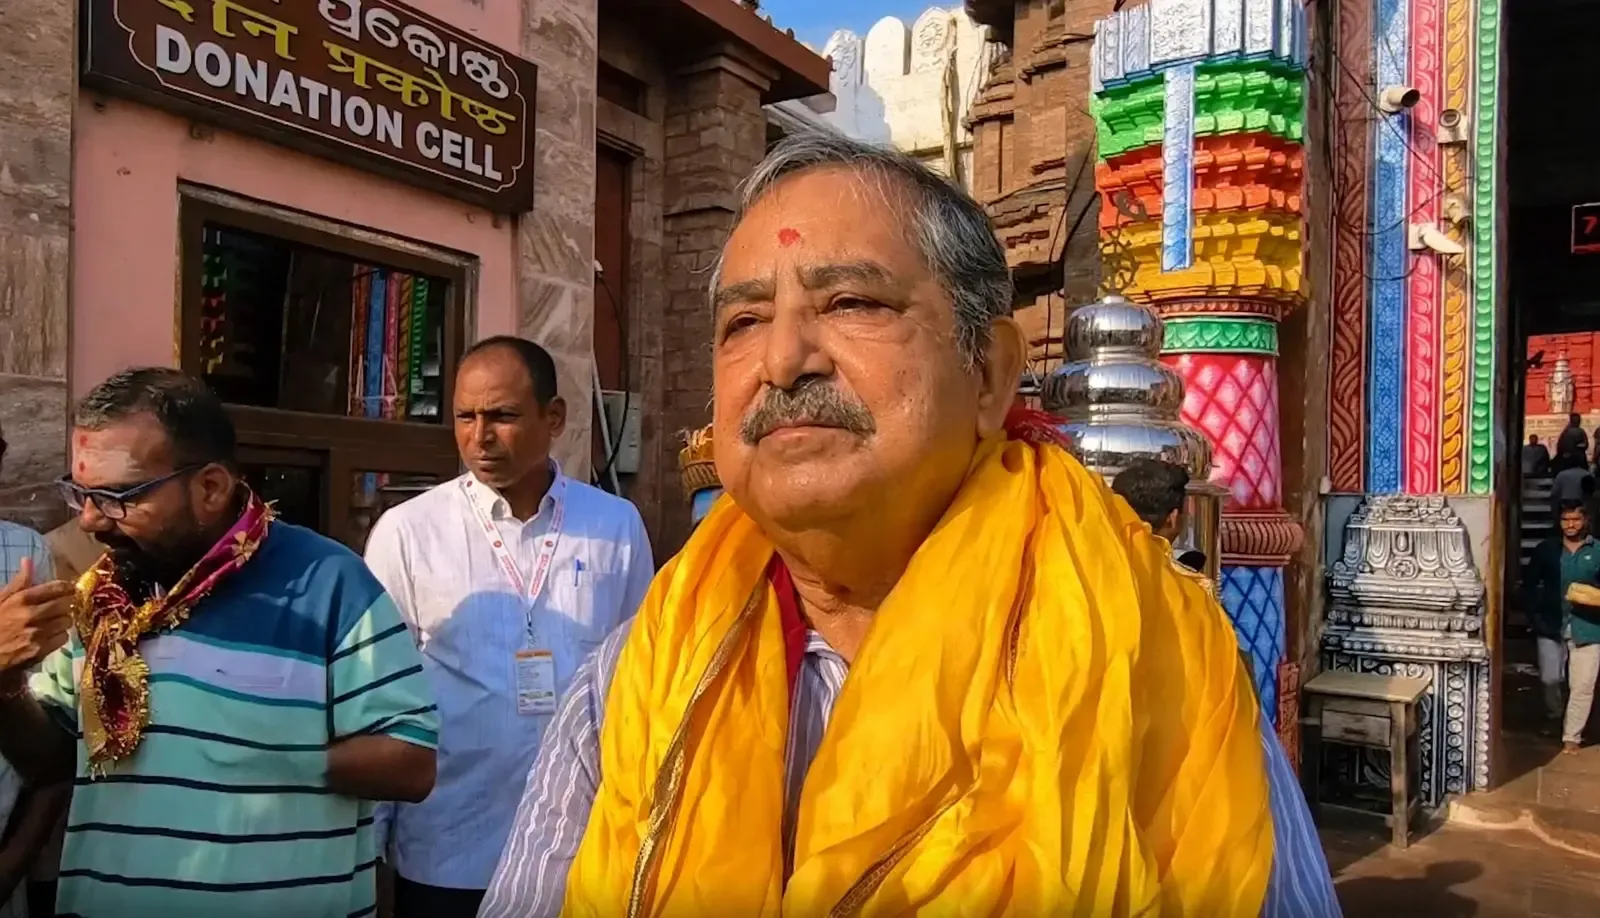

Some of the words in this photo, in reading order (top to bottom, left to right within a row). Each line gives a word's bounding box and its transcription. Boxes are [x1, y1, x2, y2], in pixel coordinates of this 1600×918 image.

[156, 23, 403, 149] DONATION
[415, 121, 502, 182] CELL
[322, 39, 516, 135] प्रकोष्ठ
